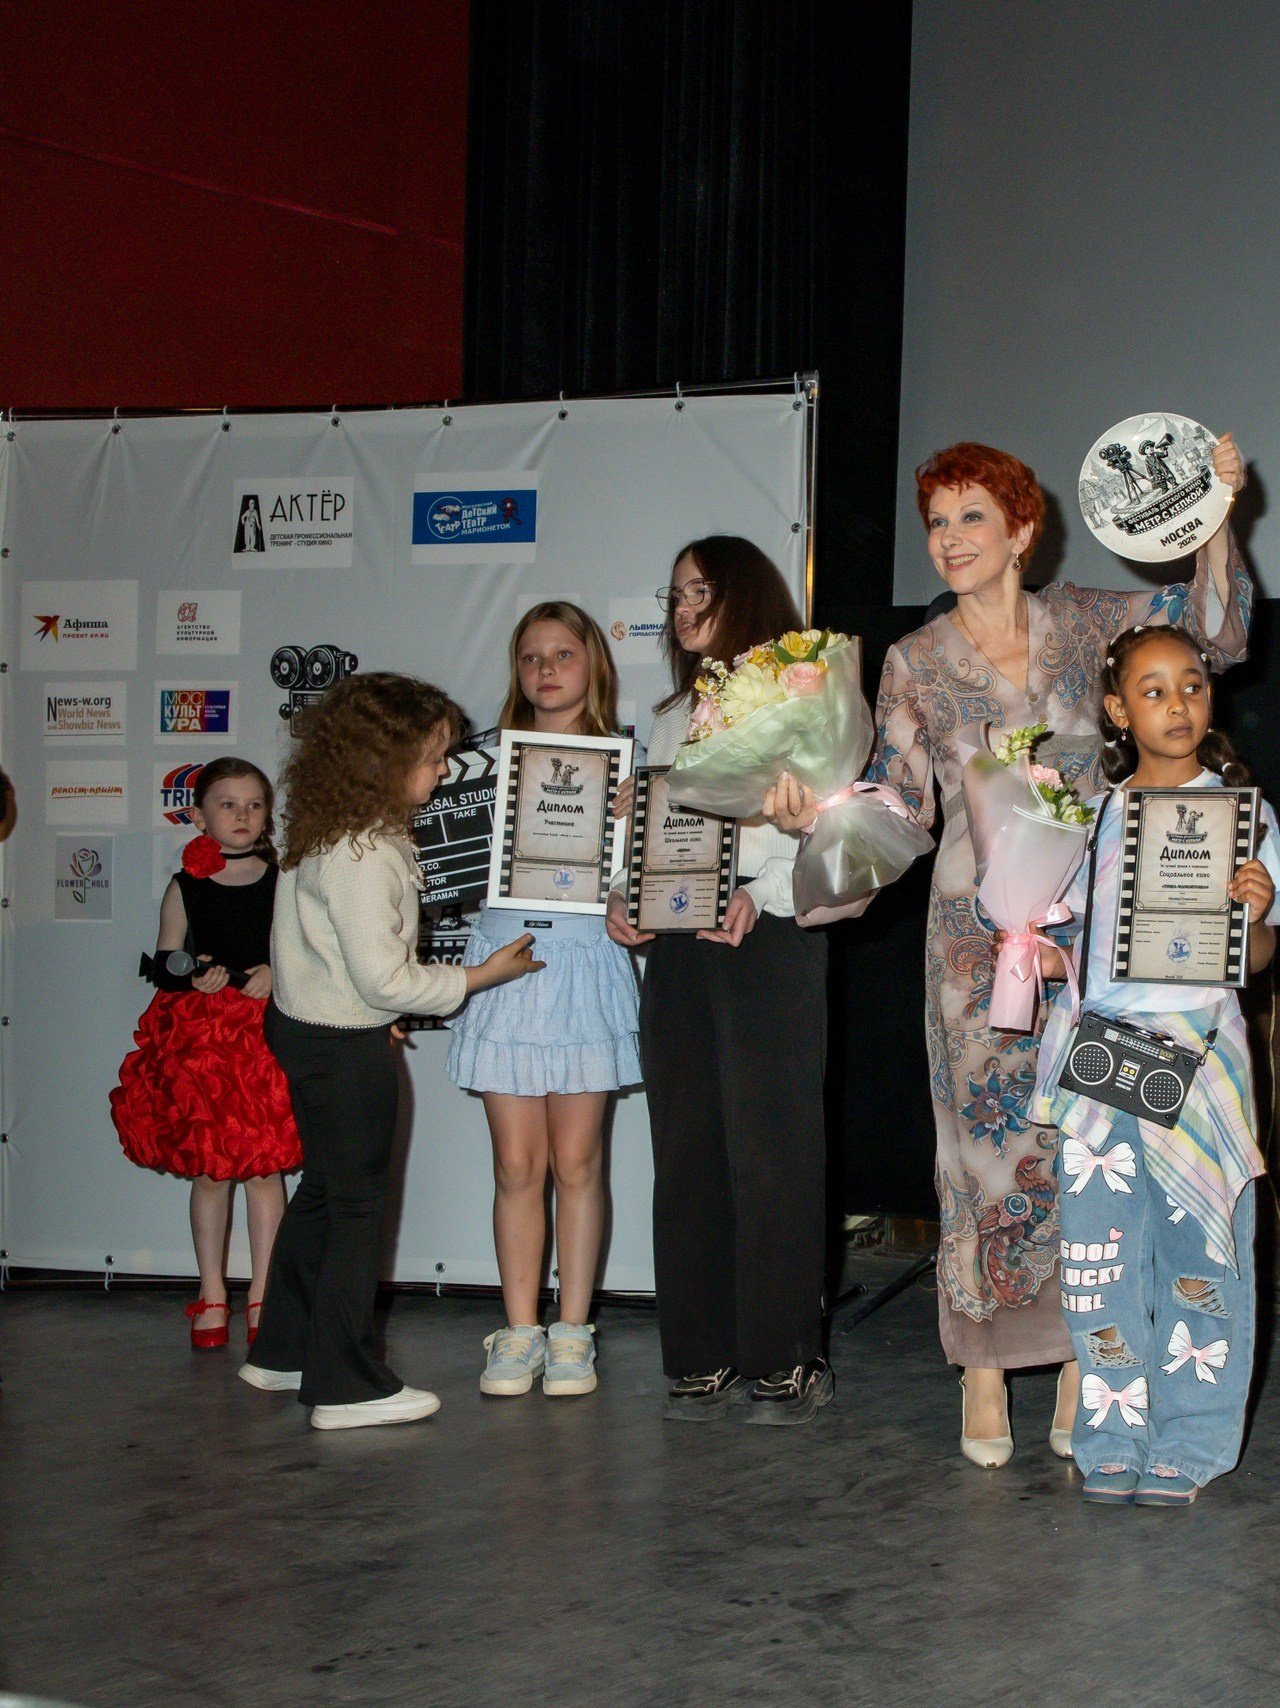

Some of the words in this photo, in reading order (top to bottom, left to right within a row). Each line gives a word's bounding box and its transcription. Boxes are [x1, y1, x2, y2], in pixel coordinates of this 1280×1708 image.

[269, 489, 346, 523] АКТЁР
[269, 533, 294, 541] ДЕТСКАЯ
[294, 532, 353, 540] ПРОФЕССИОНАЛЬНАЯ
[1160, 517, 1204, 548] МОСКВА
[1177, 533, 1198, 550] 2026
[63, 618, 109, 631] Афиша
[47, 696, 112, 723] News-w.org
[58, 707, 85, 719] World
[86, 708, 111, 718] News
[164, 704, 202, 718] КУЛЬТ
[58, 719, 95, 730] Showbiz
[96, 719, 122, 730] News
[164, 717, 202, 731] УРА
[51, 785, 123, 796] репост-принт
[160, 788, 195, 807] TRI
[452, 808, 477, 819] TAKE
[536, 799, 584, 815] Диплом
[663, 815, 705, 830] Диплом
[1159, 845, 1211, 862] Диплом
[57, 880, 84, 888] FLOWER
[91, 879, 109, 888] HOLD
[1060, 1238, 1120, 1262] GOOD
